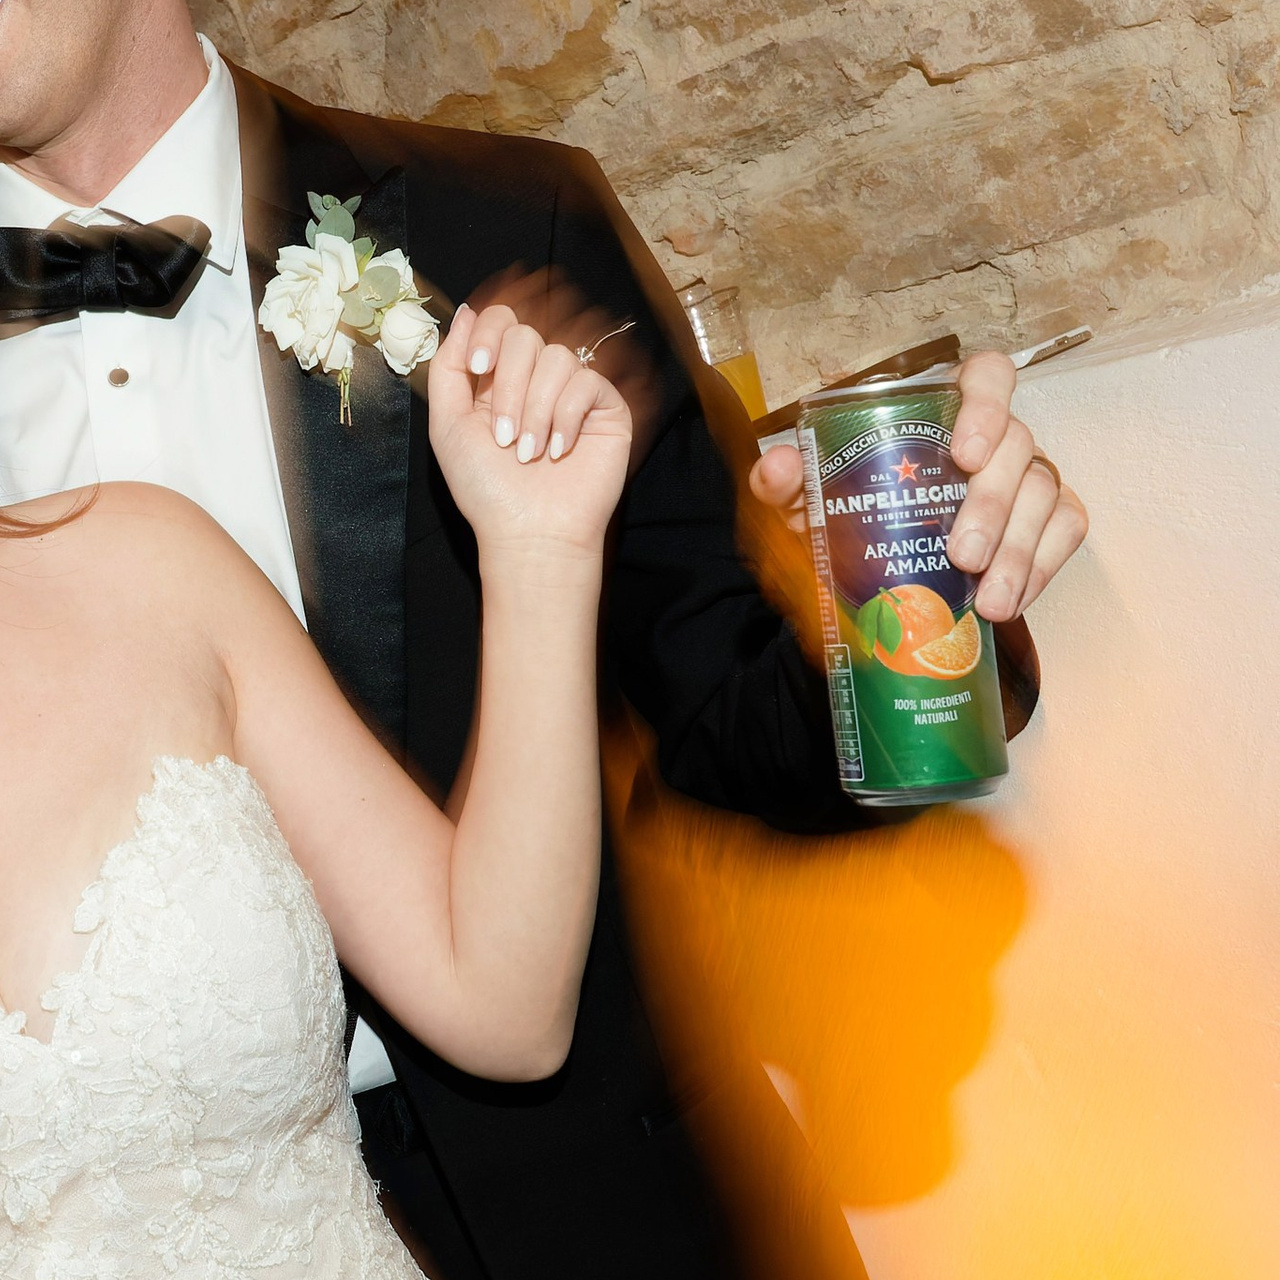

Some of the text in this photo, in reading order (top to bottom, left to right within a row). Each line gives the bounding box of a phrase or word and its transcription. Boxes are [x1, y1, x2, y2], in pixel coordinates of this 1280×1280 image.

[820, 457, 843, 477] SOLO
[842, 432, 879, 461] SUCCHI
[879, 426, 898, 439] DA
[900, 424, 942, 440] ARANCE
[870, 467, 942, 483] DAL 1932
[825, 482, 967, 516] SANPELLEGRIN
[862, 516, 873, 524] LE
[877, 510, 910, 522] BIBITE
[864, 535, 950, 560] ARANCIA
[884, 555, 951, 577] AMARA
[894, 690, 972, 710] 100% INGREDIENTI
[914, 709, 958, 725] NATURALI
